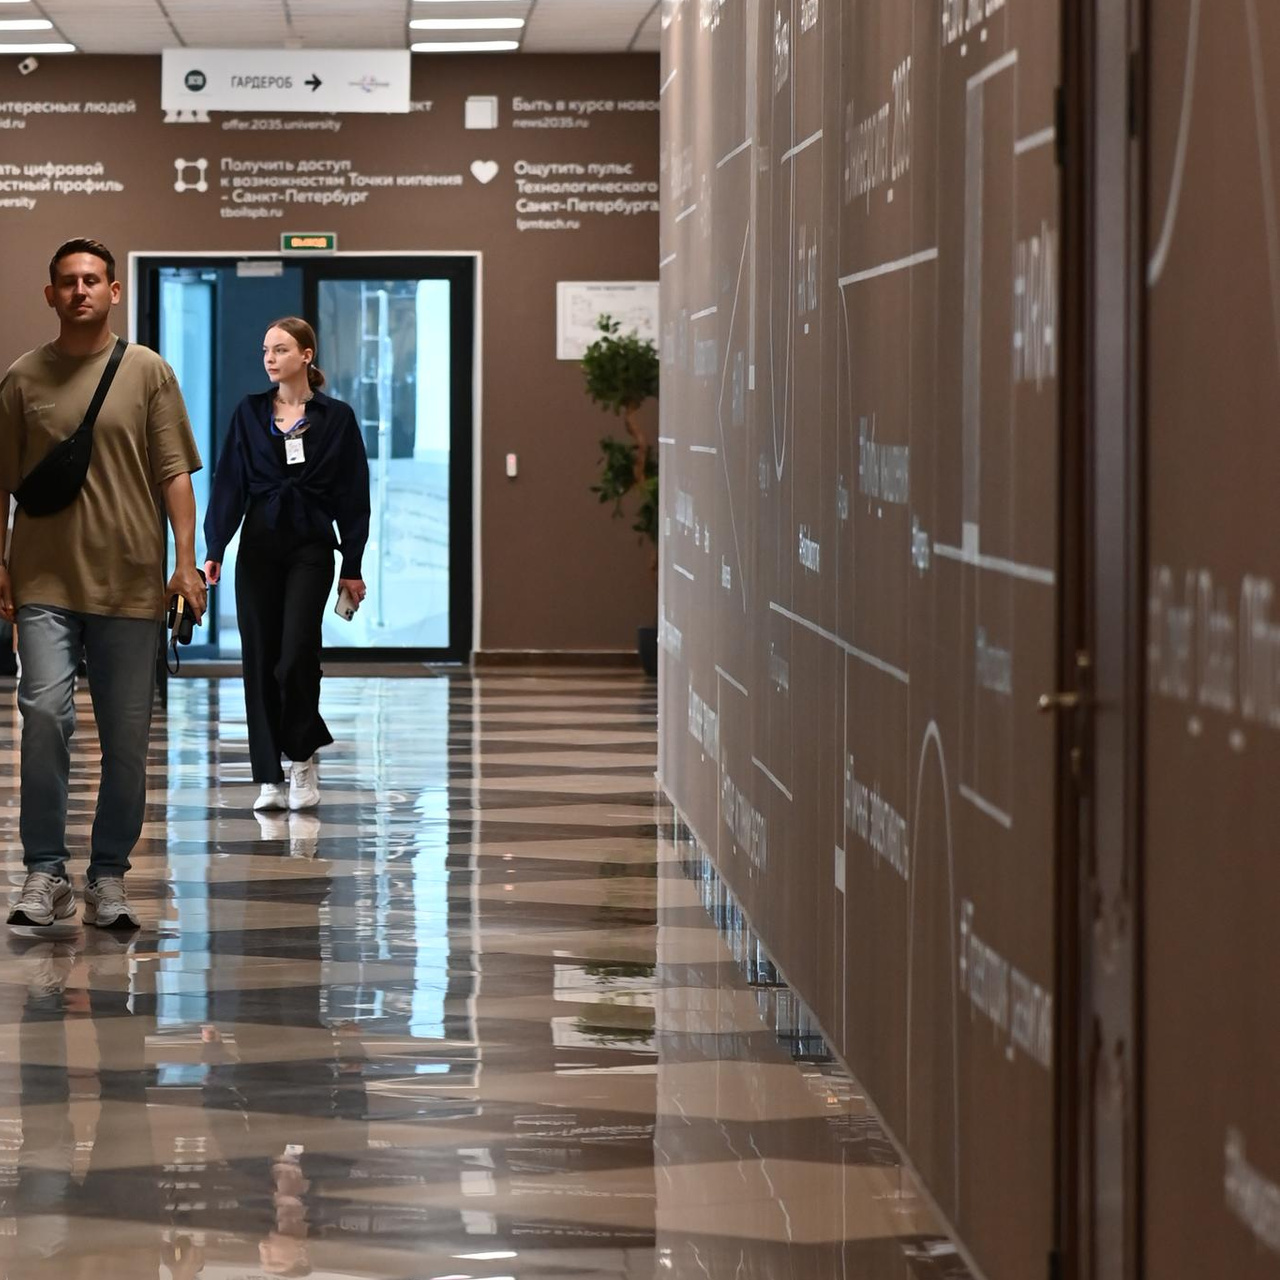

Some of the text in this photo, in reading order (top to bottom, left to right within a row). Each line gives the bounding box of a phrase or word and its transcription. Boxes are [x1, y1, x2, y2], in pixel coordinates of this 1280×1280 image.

[231, 75, 293, 90] ГАРДЕРОБ
[84, 99, 137, 115] людей
[512, 96, 553, 111] Быть
[556, 100, 566, 111] в
[568, 101, 615, 115] курсе
[221, 118, 342, 133] offer.2035.university
[512, 116, 590, 129] news2035.ru
[23, 161, 104, 178] цифровой
[220, 157, 352, 174] Получить доступ
[513, 160, 632, 178] Ощутить пульс
[53, 177, 124, 194] профиль
[220, 172, 463, 187] к возможностям Точки кипения
[515, 179, 659, 194] Технологического
[232, 188, 369, 206] Санкт-Петербург
[220, 206, 284, 219] tboilspb.ru
[515, 197, 660, 215] Санкт-Петербурга
